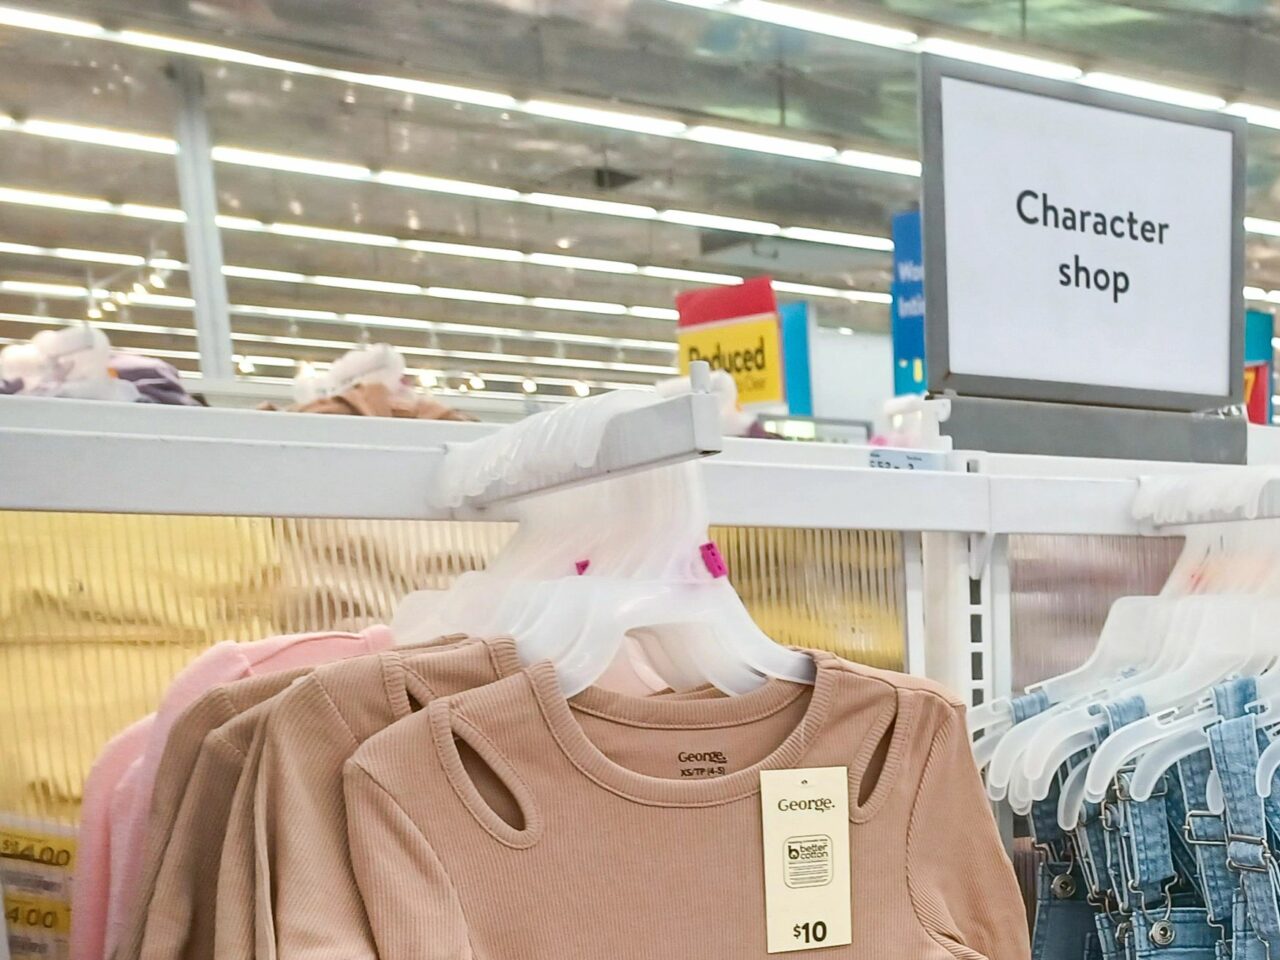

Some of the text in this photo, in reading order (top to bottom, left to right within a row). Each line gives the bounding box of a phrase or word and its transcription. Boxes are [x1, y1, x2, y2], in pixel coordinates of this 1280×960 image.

[1016, 189, 1169, 245] Character
[1059, 254, 1130, 304] shop
[689, 335, 765, 373] Rduced
[800, 843, 828, 853] better
[800, 851, 828, 860] cotton
[793, 921, 827, 943] $10
